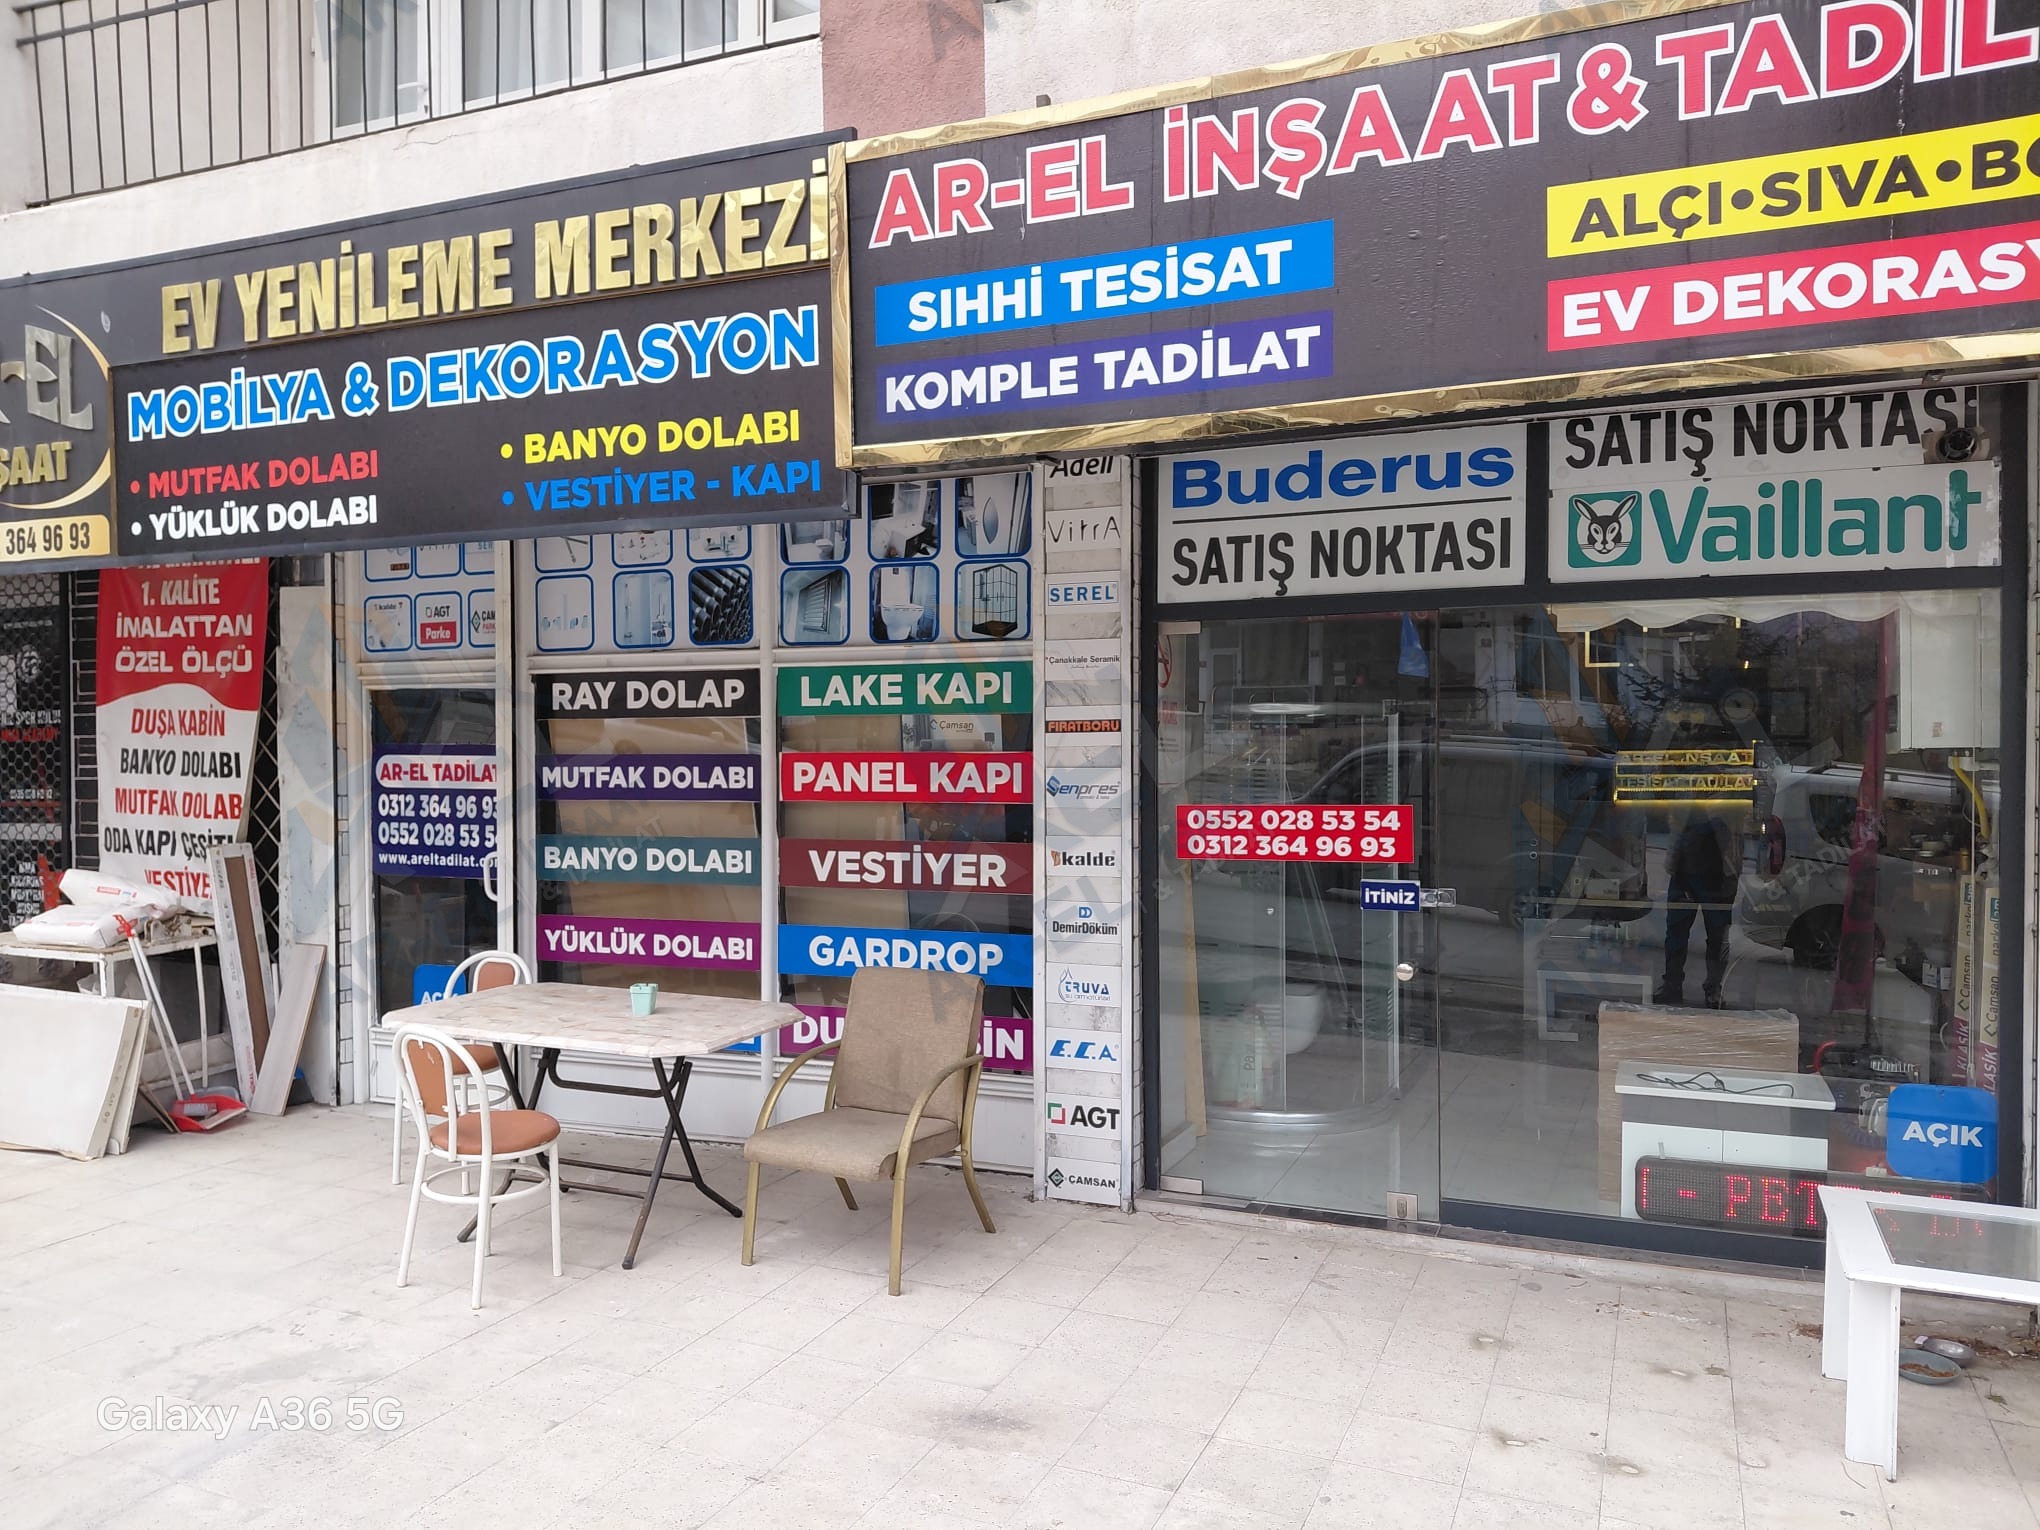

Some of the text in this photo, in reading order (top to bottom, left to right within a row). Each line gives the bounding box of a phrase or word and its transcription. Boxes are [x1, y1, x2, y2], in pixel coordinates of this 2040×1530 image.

[868, 134, 1135, 249] AR-EL
[1163, 52, 1561, 203] İNŞAAT
[1566, 42, 1649, 136] &
[1972, 135, 2040, 190] B
[162, 157, 829, 354] EV YENİLEME MERKEZİ
[908, 239, 1293, 332] SIHHİ TESİSAT
[1563, 285, 1651, 338] EV
[128, 304, 819, 441] MOBİLYA & DEKORASYON
[885, 325, 1321, 414] KOMPLE TADİLAT
[524, 409, 801, 464] BANYO DOLABI
[1565, 386, 1977, 478] SATIŞ NOKTASI
[149, 450, 379, 500] MUTFAK DOLABI
[525, 467, 695, 511] VESTİYER
[732, 459, 821, 497] KAPI
[1172, 447, 1515, 509] Buderus
[149, 496, 378, 541] YÜKLÜK DOLABI
[1048, 516, 1120, 542] VitrA
[1649, 469, 1982, 564] Vaillant
[6, 521, 90, 556] 364 96 93
[1171, 517, 1511, 596] SATIŞ NOKTASI
[142, 573, 220, 606] 1. KALİTE
[1050, 585, 1114, 602] SEREL
[116, 612, 252, 638] İMALATTAN
[434, 605, 450, 617] AGT
[426, 626, 451, 640] Parke
[115, 644, 252, 678] ÖZEL ÖLÇÜ
[552, 679, 745, 710] RAY DOLAP
[801, 672, 1012, 706] LAKE KAPI
[131, 704, 225, 739] DUŞA KABİN
[1048, 720, 1119, 732] FIRATBORU
[120, 748, 241, 778] BANYO DOLABI
[380, 763, 428, 781] AR-EL
[542, 766, 753, 789] MUTFAK DOLABI
[793, 762, 1022, 793] PANEL KAPI
[115, 788, 178, 816] MUTFAK
[378, 794, 415, 817] 0312
[420, 795, 451, 818] 364
[456, 795, 477, 818] 96
[378, 821, 497, 848] 0552 028 53 5
[1187, 810, 1400, 831] 0552 028 53 54
[104, 827, 133, 853] ODA
[135, 828, 176, 856] KAPI
[1187, 835, 1396, 857] 0312 364 96 93
[544, 847, 752, 873] BANYO DOLABI
[808, 845, 1006, 887] VESTİYER
[1062, 852, 1115, 866] kalde
[1364, 886, 1416, 906] İTİNİZ
[545, 925, 753, 960] YÜKLÜK DOLABI
[1053, 921, 1117, 935] DemirDöküm
[809, 935, 1003, 974] GARDROP
[1070, 1105, 1120, 1129] AGT
[1902, 1121, 1984, 1149] AÇIK
[1069, 1175, 1115, 1188] CAMSAN
